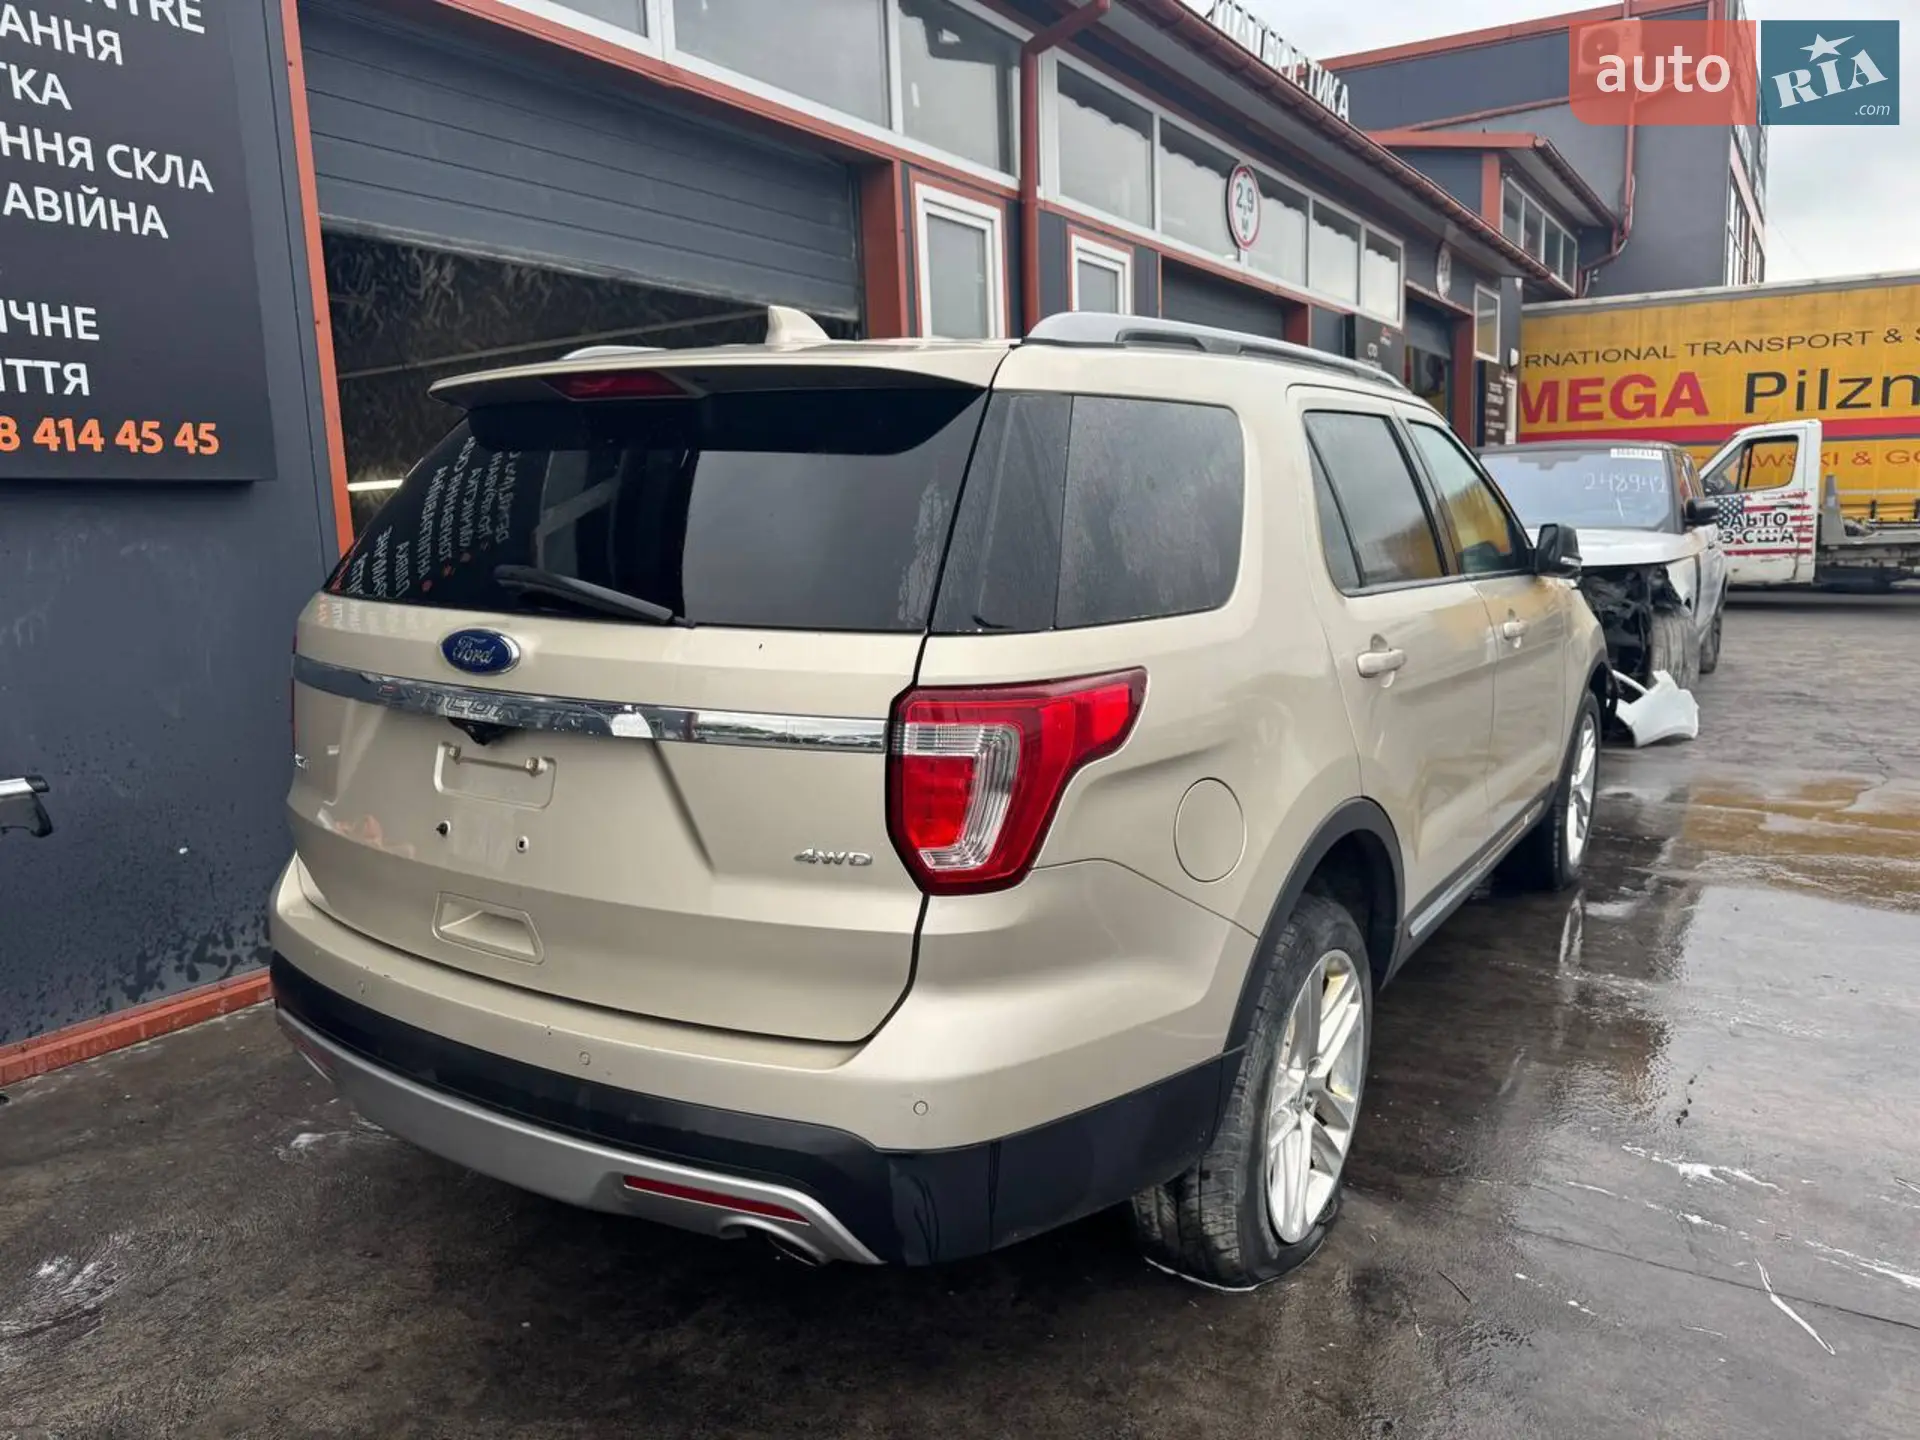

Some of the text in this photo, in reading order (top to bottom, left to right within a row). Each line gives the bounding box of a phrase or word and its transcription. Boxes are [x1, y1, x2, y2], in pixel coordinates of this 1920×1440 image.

[0, 3, 124, 67] АННЯ
[106, 143, 214, 193] СКЛА
[3, 181, 169, 240] АВІЙНА
[1525, 344, 1677, 368] RNATIONAL
[1684, 330, 1874, 358] TRANSPORT
[1883, 327, 1903, 344] &
[1520, 367, 1920, 424] MEGA Pilzn
[33, 416, 105, 453] 414
[115, 419, 164, 455] 45
[174, 421, 220, 456] 45
[1885, 447, 1920, 465] G
[452, 635, 496, 665] Ford
[793, 847, 873, 867] 4WD
